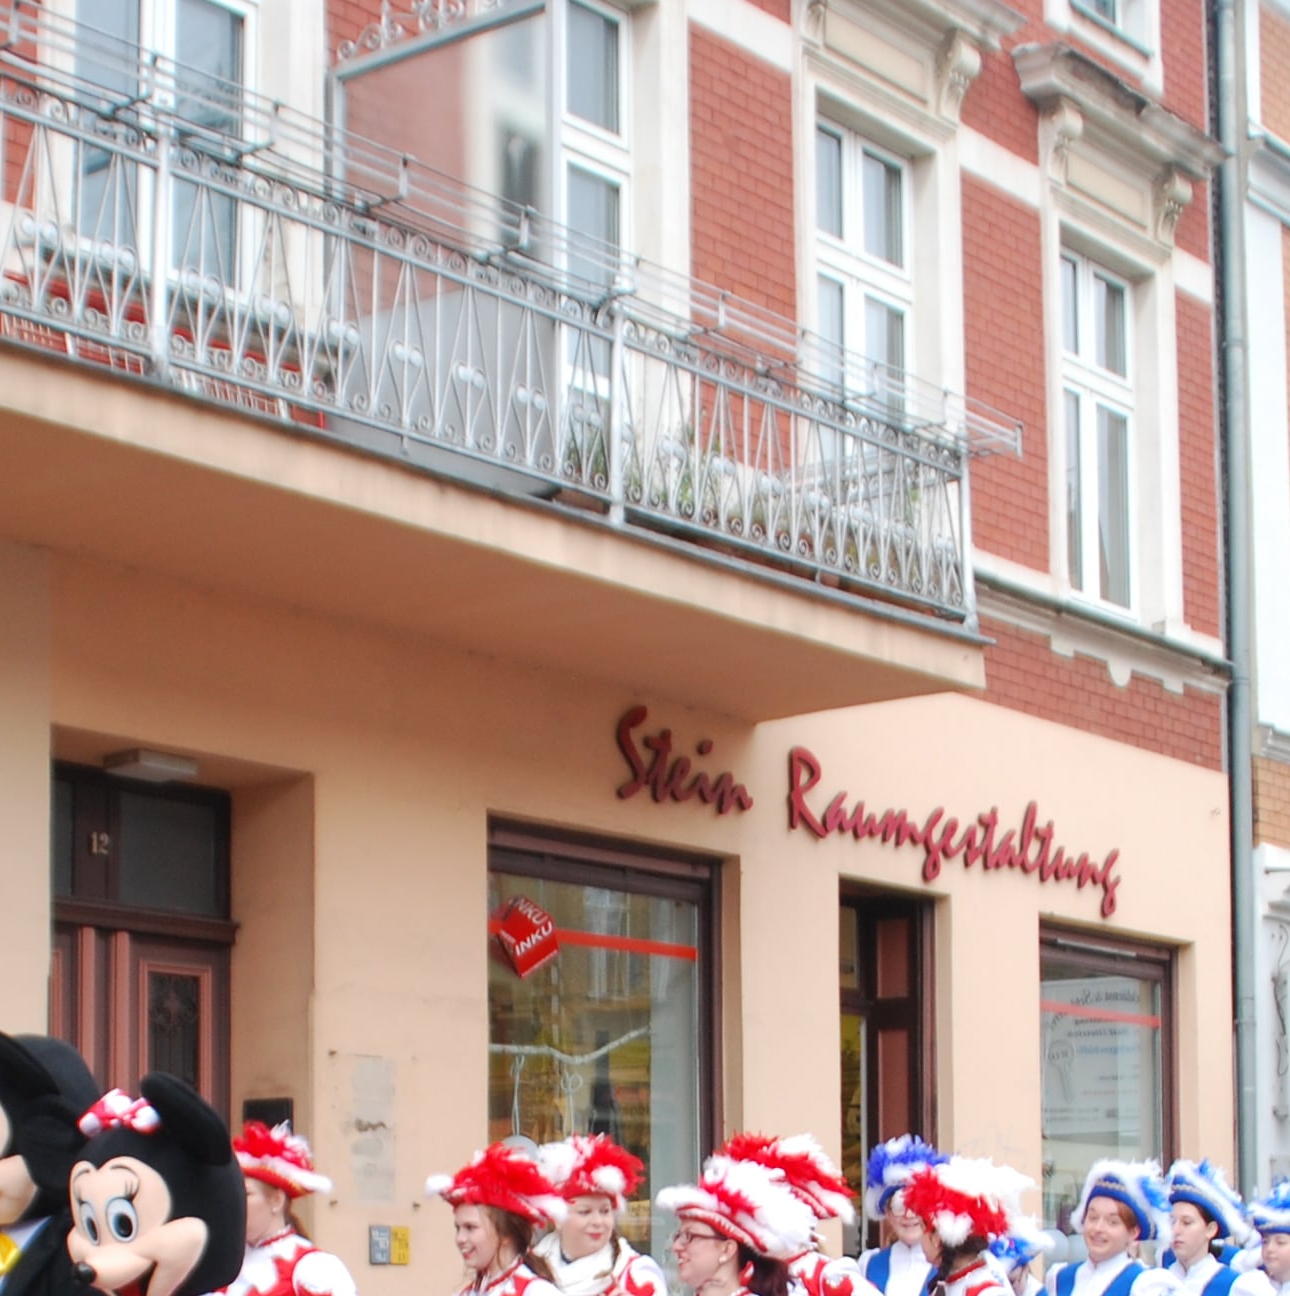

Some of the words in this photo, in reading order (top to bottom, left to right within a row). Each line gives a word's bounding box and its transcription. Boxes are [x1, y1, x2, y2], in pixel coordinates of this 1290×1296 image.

[616, 705, 753, 814] Stein
[788, 746, 1121, 918] Raumgestaltung
[90, 831, 109, 855] 12
[515, 920, 553, 956] INKU
